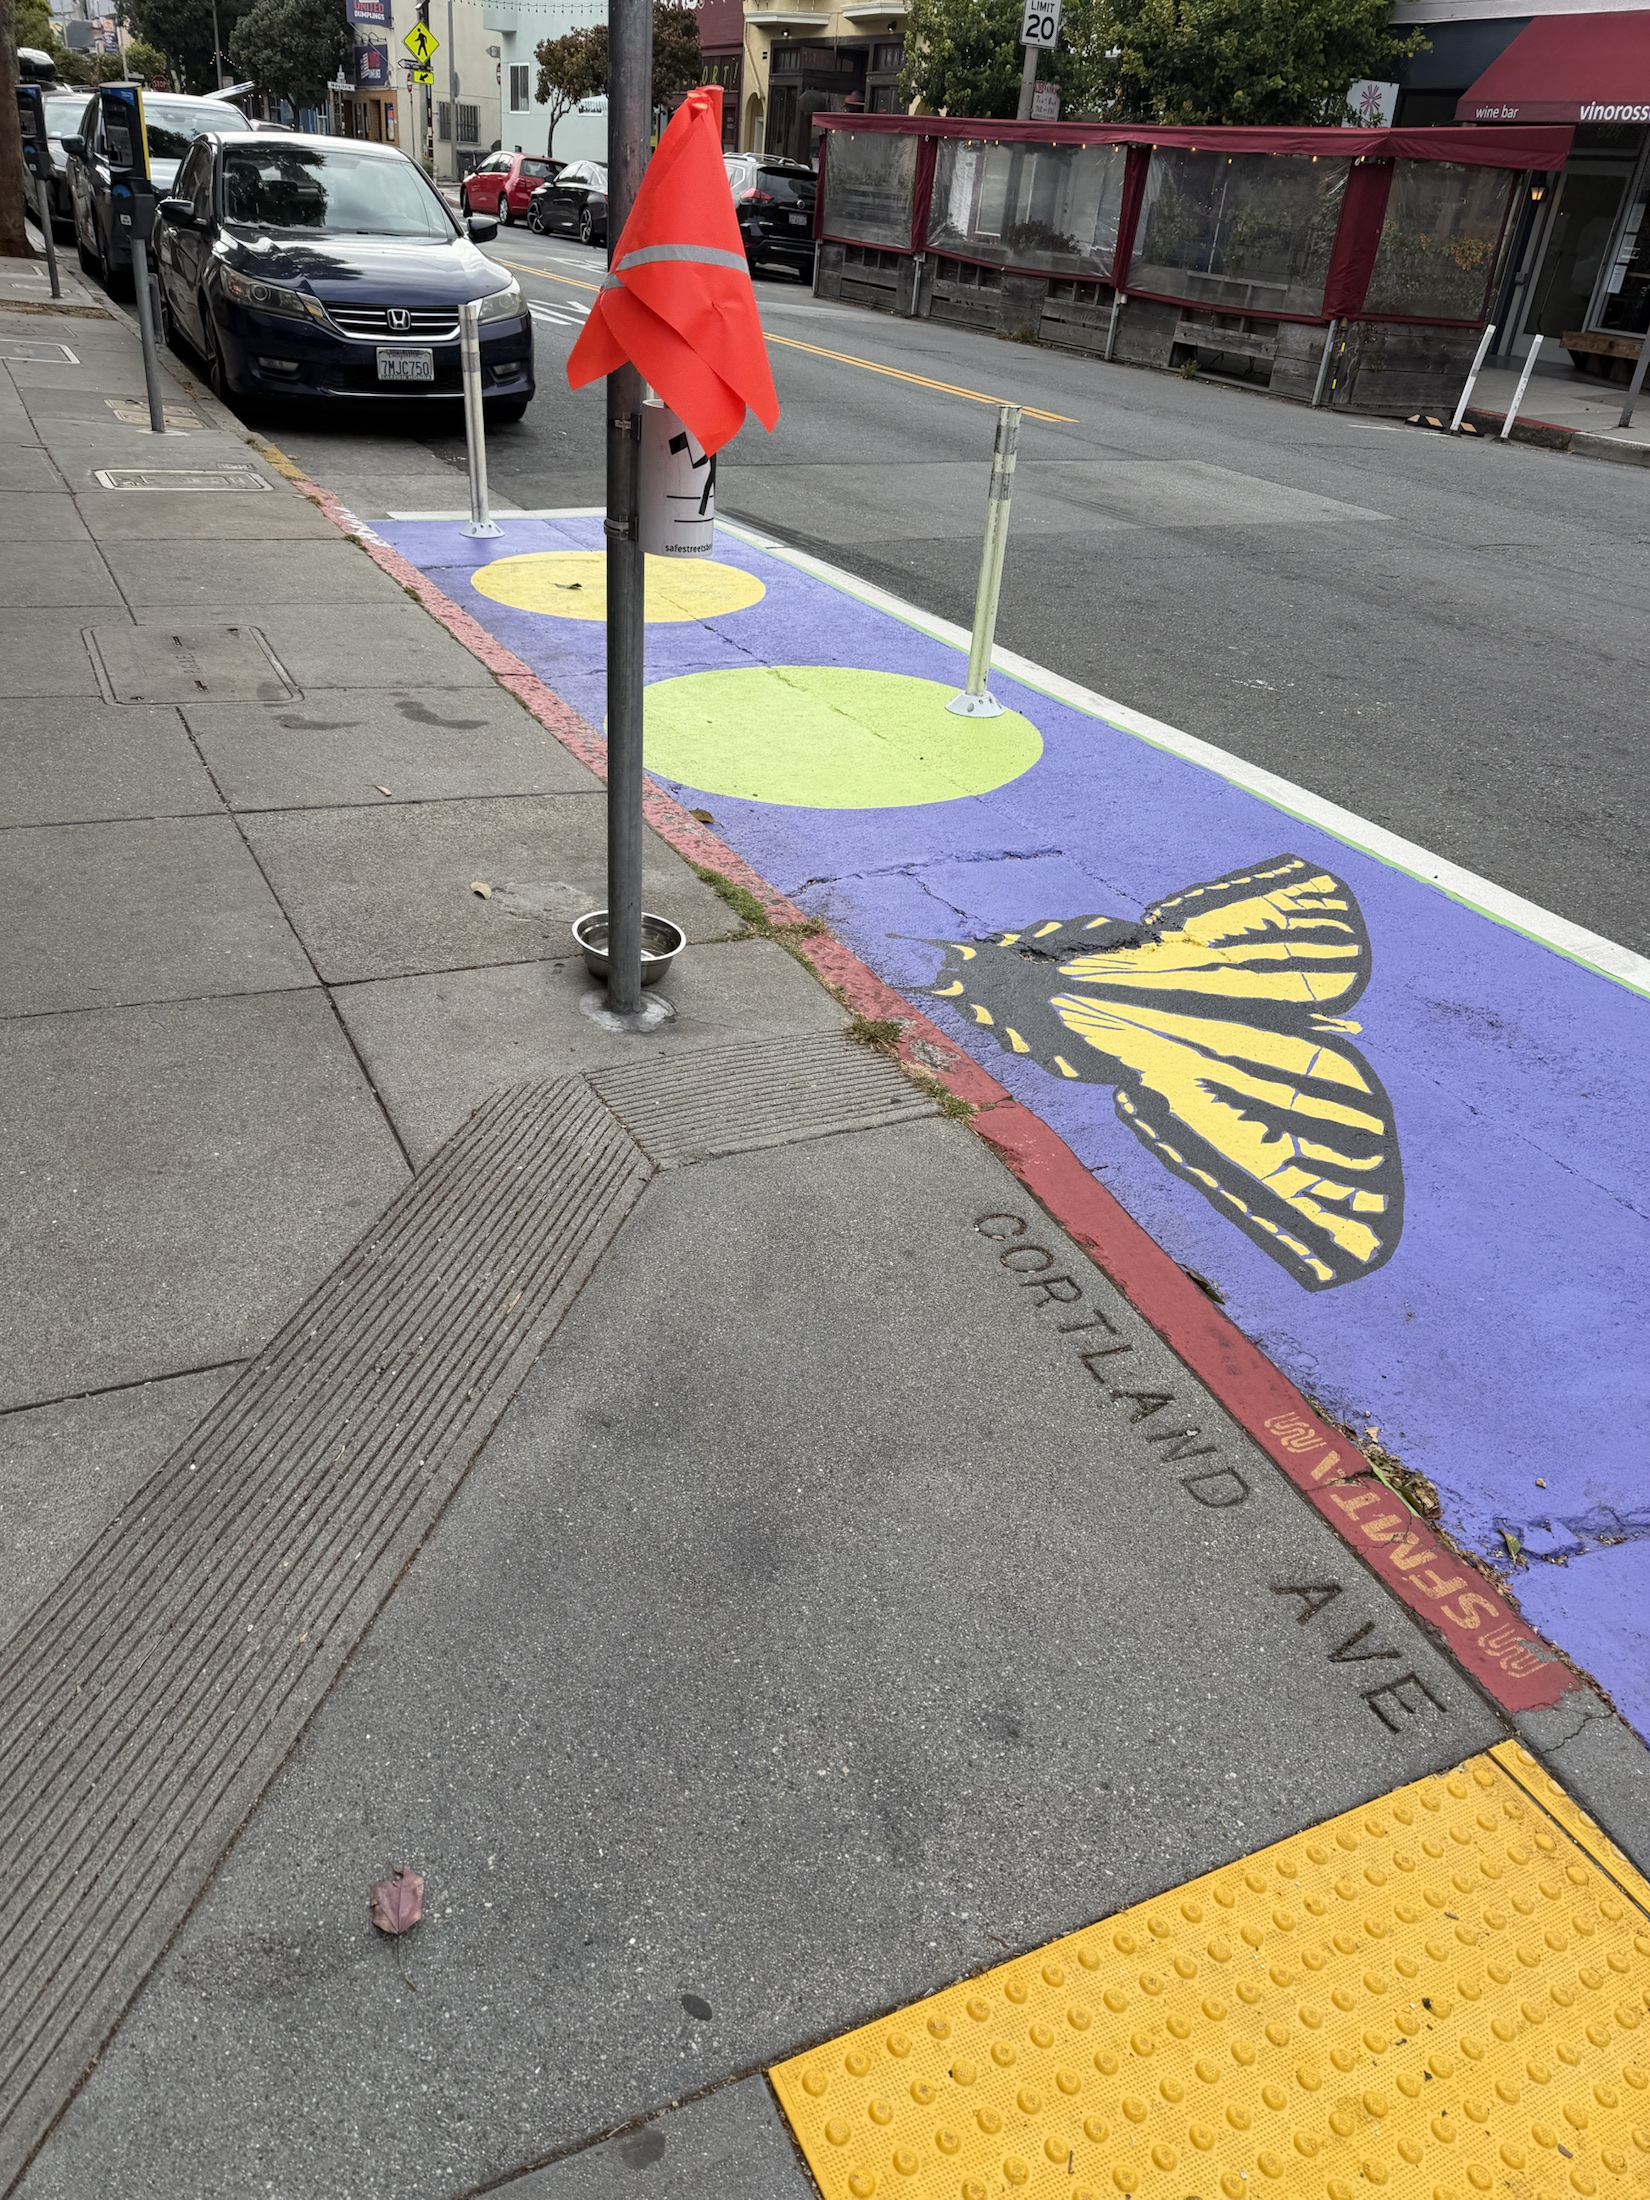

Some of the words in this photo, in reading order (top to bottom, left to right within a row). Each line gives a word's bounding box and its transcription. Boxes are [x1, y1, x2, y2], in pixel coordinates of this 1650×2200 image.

[354, 0, 384, 13] UNITED
[354, 10, 385, 20] DUMPLINGS
[1031, 0, 1055, 13] LIMIT
[1025, 14, 1055, 40] 20
[1475, 105, 1499, 119] wine
[1501, 104, 1519, 119] bar
[1580, 101, 1650, 120] vinoross
[381, 360, 430, 375] 7MJC750
[974, 1211, 1250, 1510] CORTLAND
[1310, 1450, 1500, 1630] SFMTA
[1269, 1580, 1449, 1735] AVE
